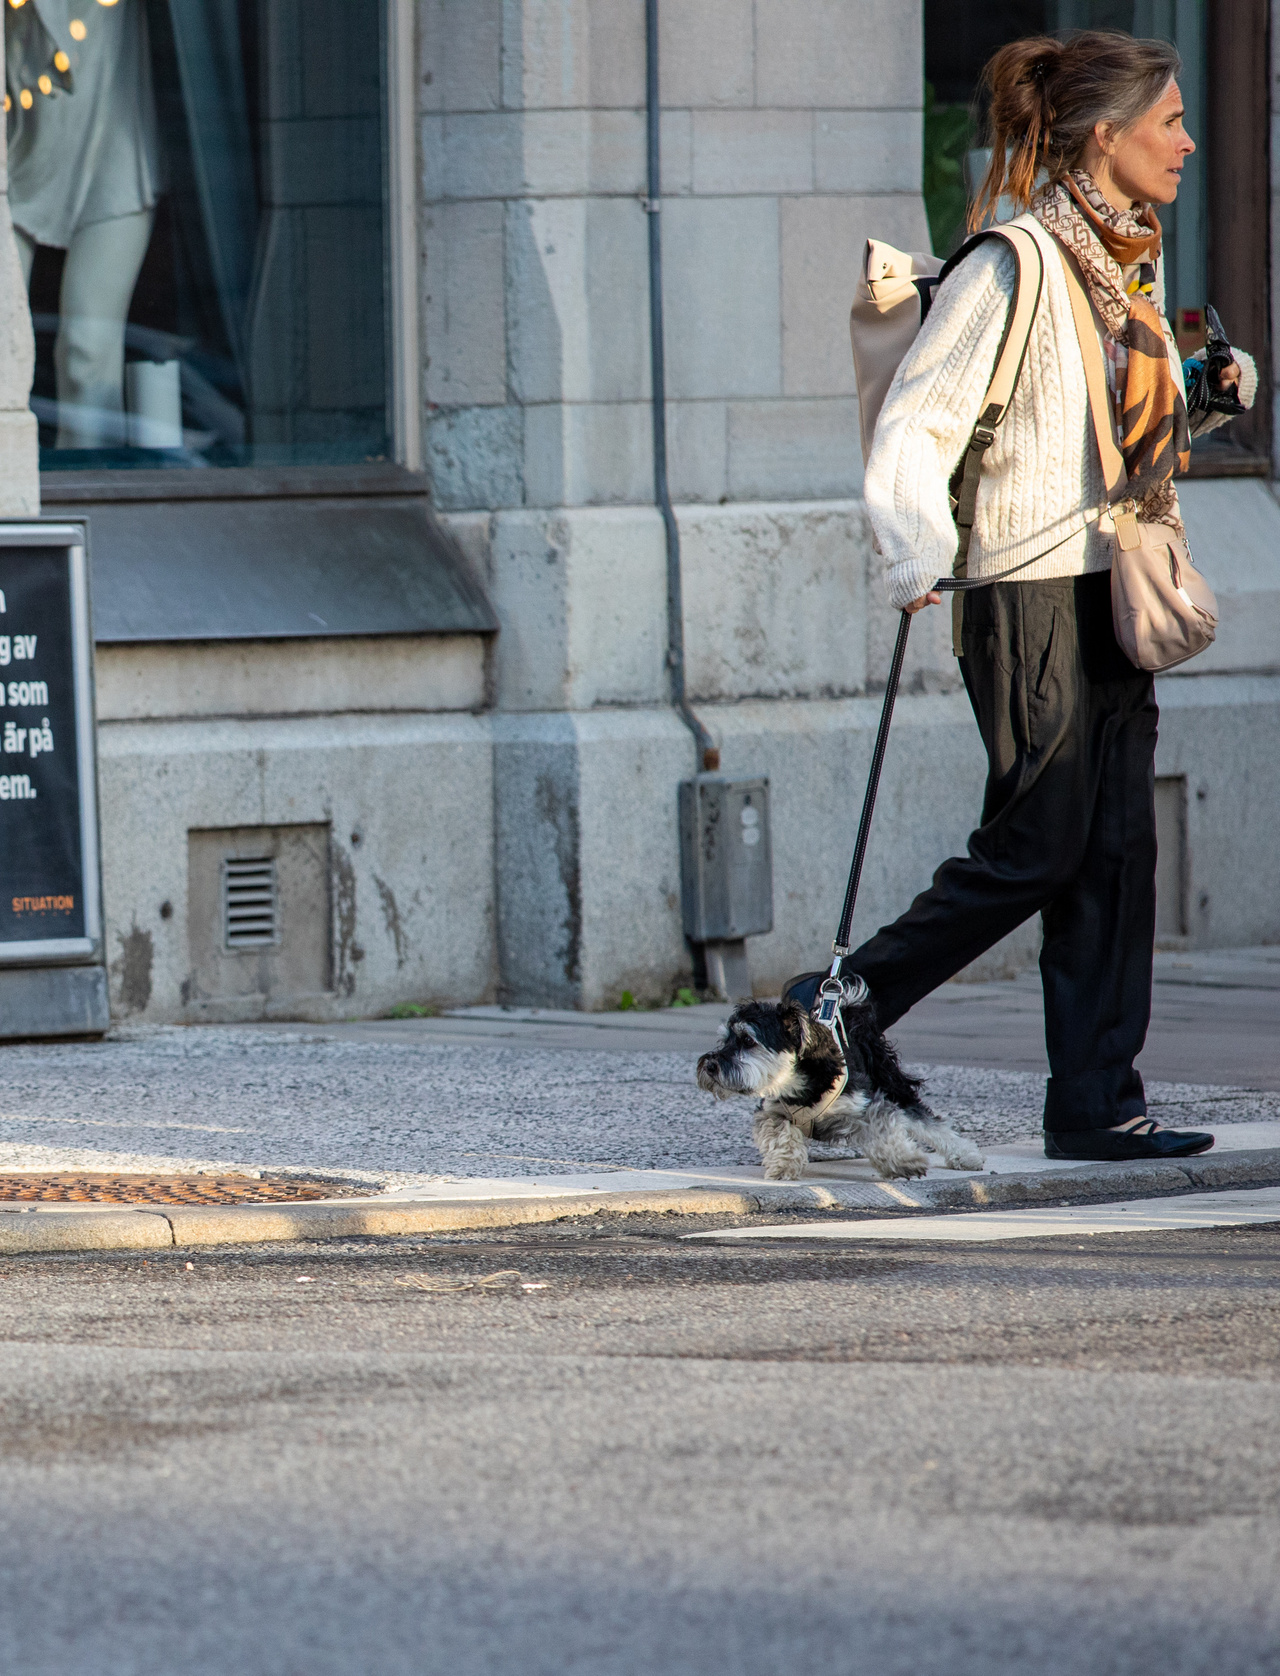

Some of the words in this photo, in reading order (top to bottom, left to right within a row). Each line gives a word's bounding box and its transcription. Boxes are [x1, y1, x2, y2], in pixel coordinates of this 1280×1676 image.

[13, 634, 37, 660] av
[8, 681, 49, 706] som
[4, 721, 27, 753] är
[29, 717, 54, 758] på
[11, 895, 74, 912] SITUATION
